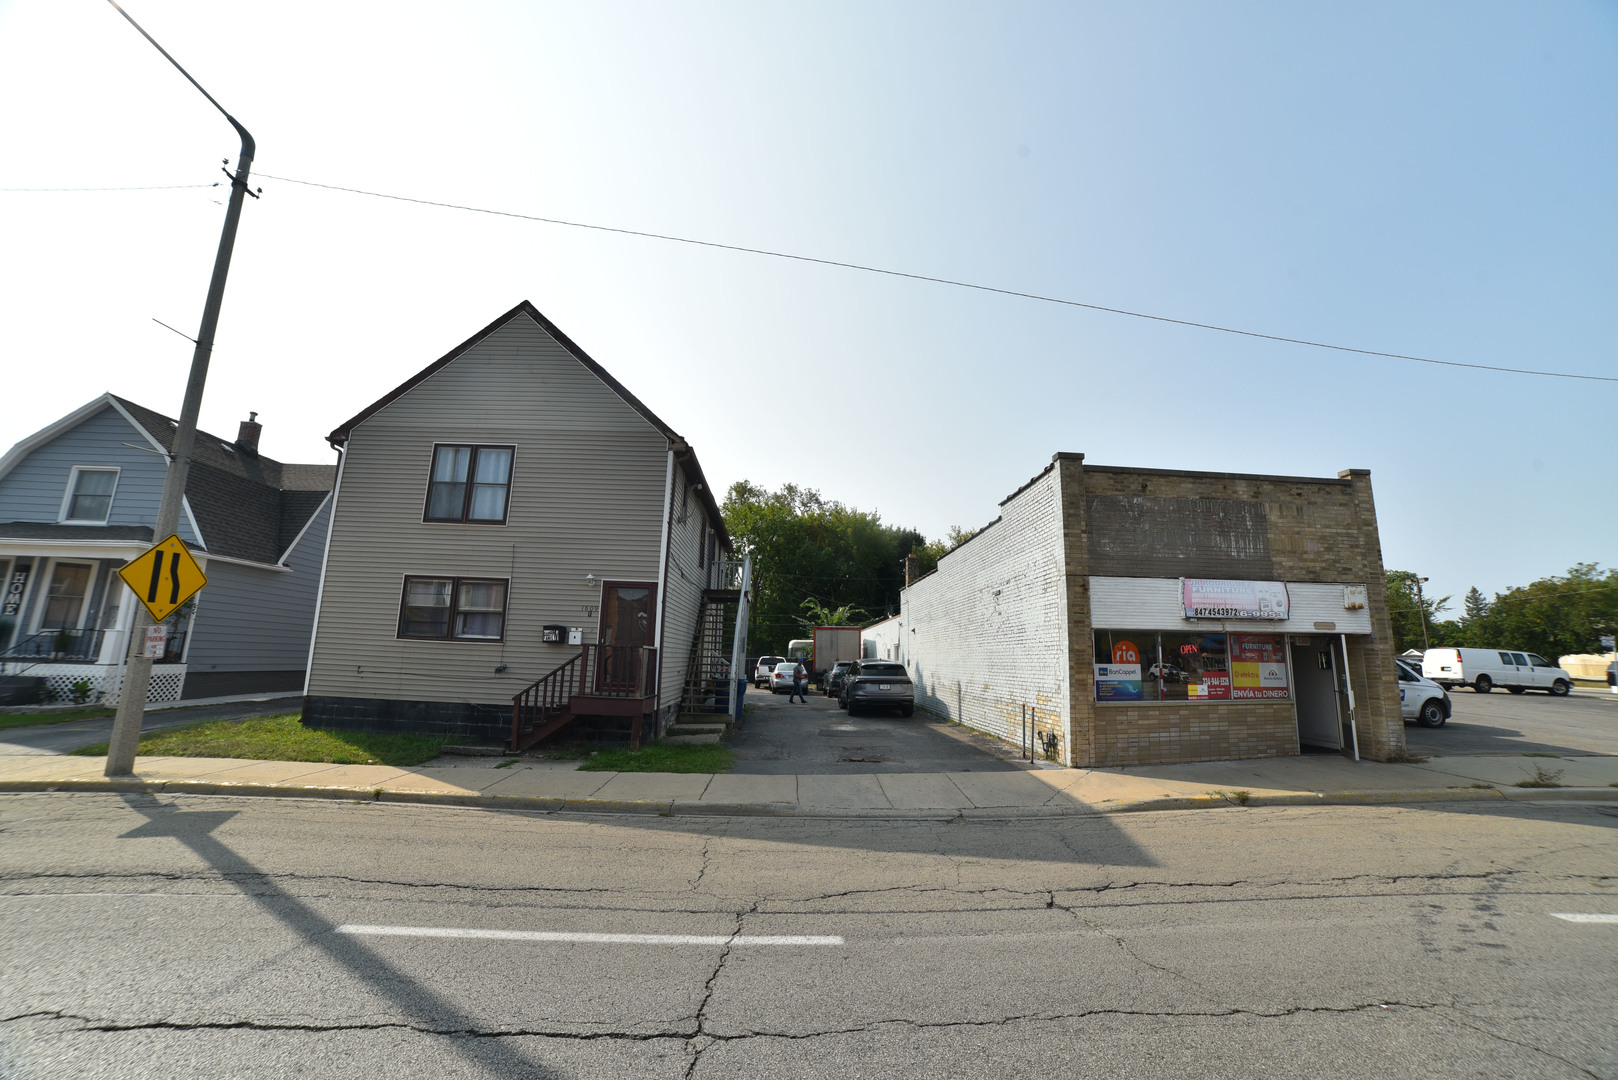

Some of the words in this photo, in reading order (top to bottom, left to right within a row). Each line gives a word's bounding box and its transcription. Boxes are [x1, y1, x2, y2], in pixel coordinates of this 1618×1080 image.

[4, 572, 29, 615] HOME
[1192, 586, 1253, 594] FURNITURE
[1195, 608, 1238, 617] 8474543972
[1180, 644, 1198, 655] OPEN
[1242, 643, 1273, 651] FURNITURE
[1116, 645, 1136, 661] ria
[1233, 688, 1254, 697] ENVÍA
[1263, 690, 1288, 698] DINERO
